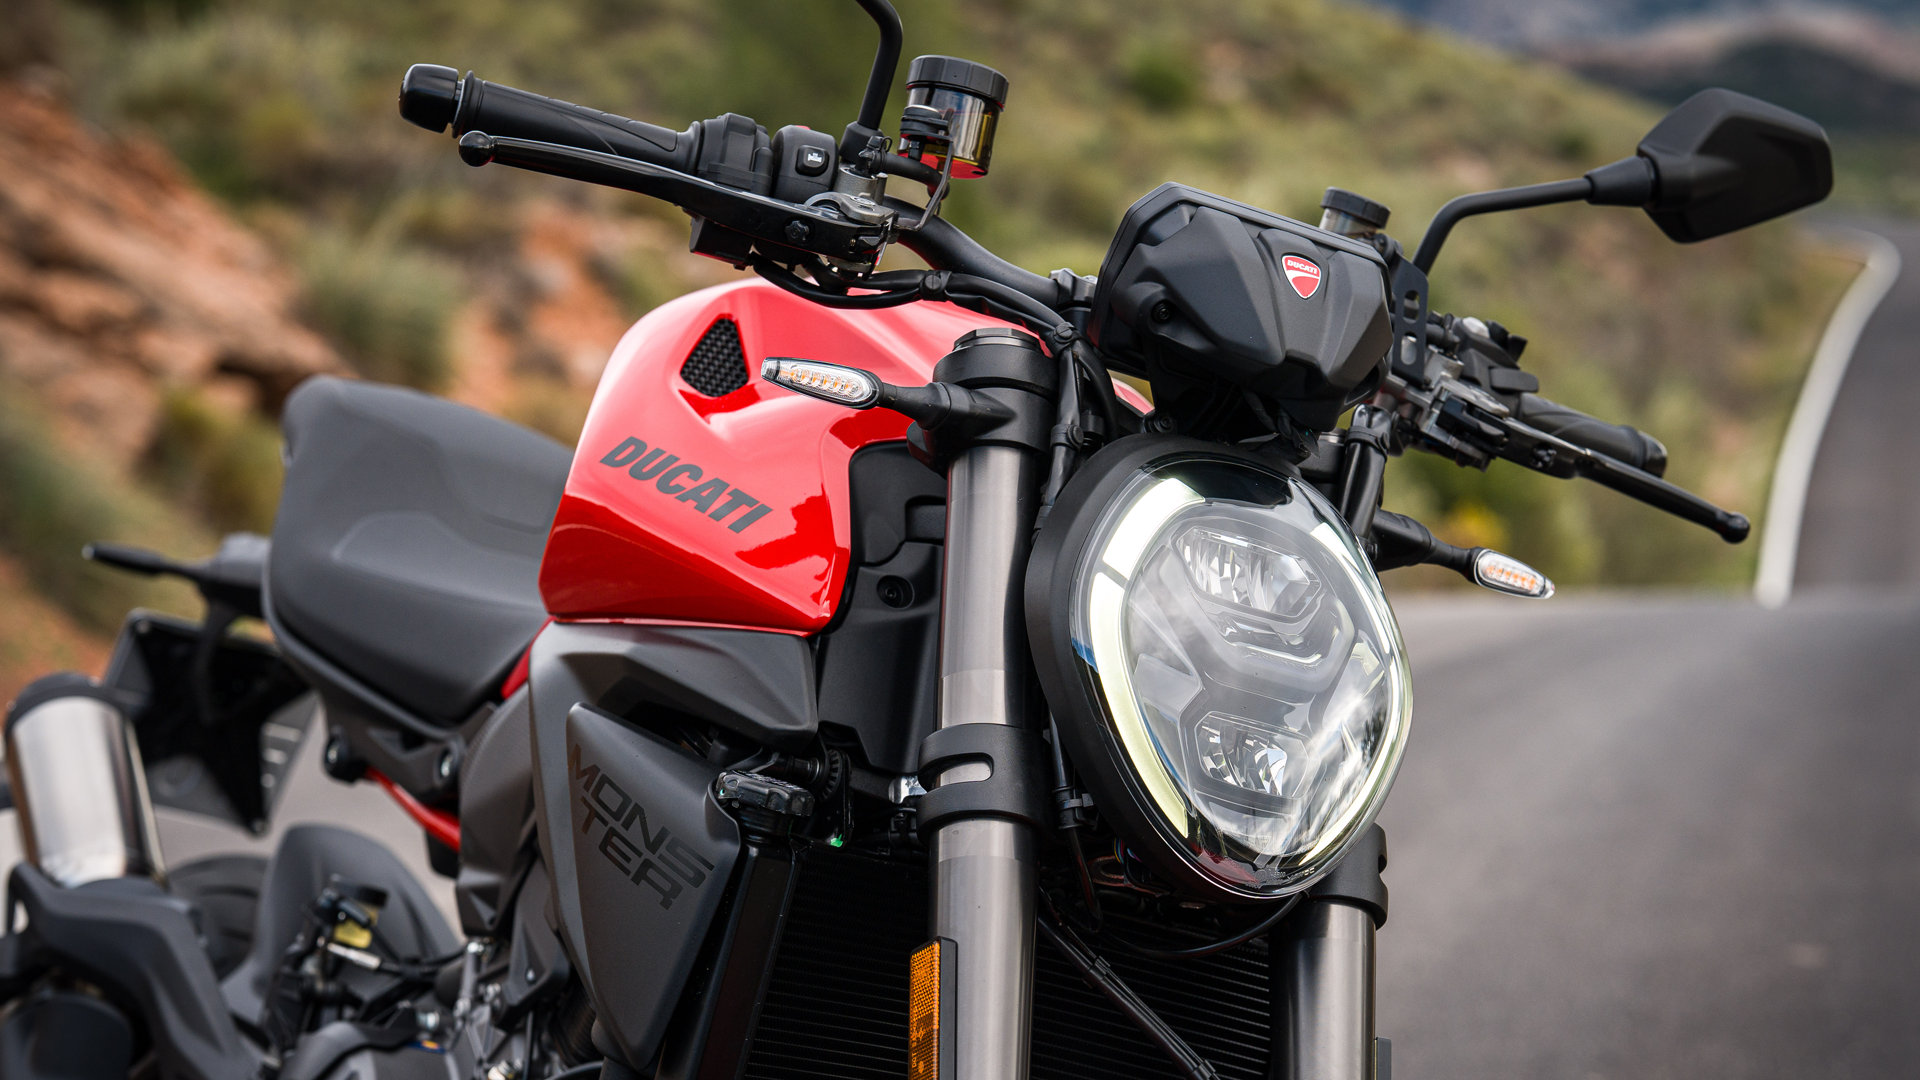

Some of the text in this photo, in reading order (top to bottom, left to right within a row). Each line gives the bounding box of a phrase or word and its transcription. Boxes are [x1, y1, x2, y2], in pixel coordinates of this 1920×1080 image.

[1287, 259, 1317, 274] DUCATI
[600, 436, 773, 534] DUCATI
[568, 744, 715, 888] MONS
[580, 797, 683, 910] TER
